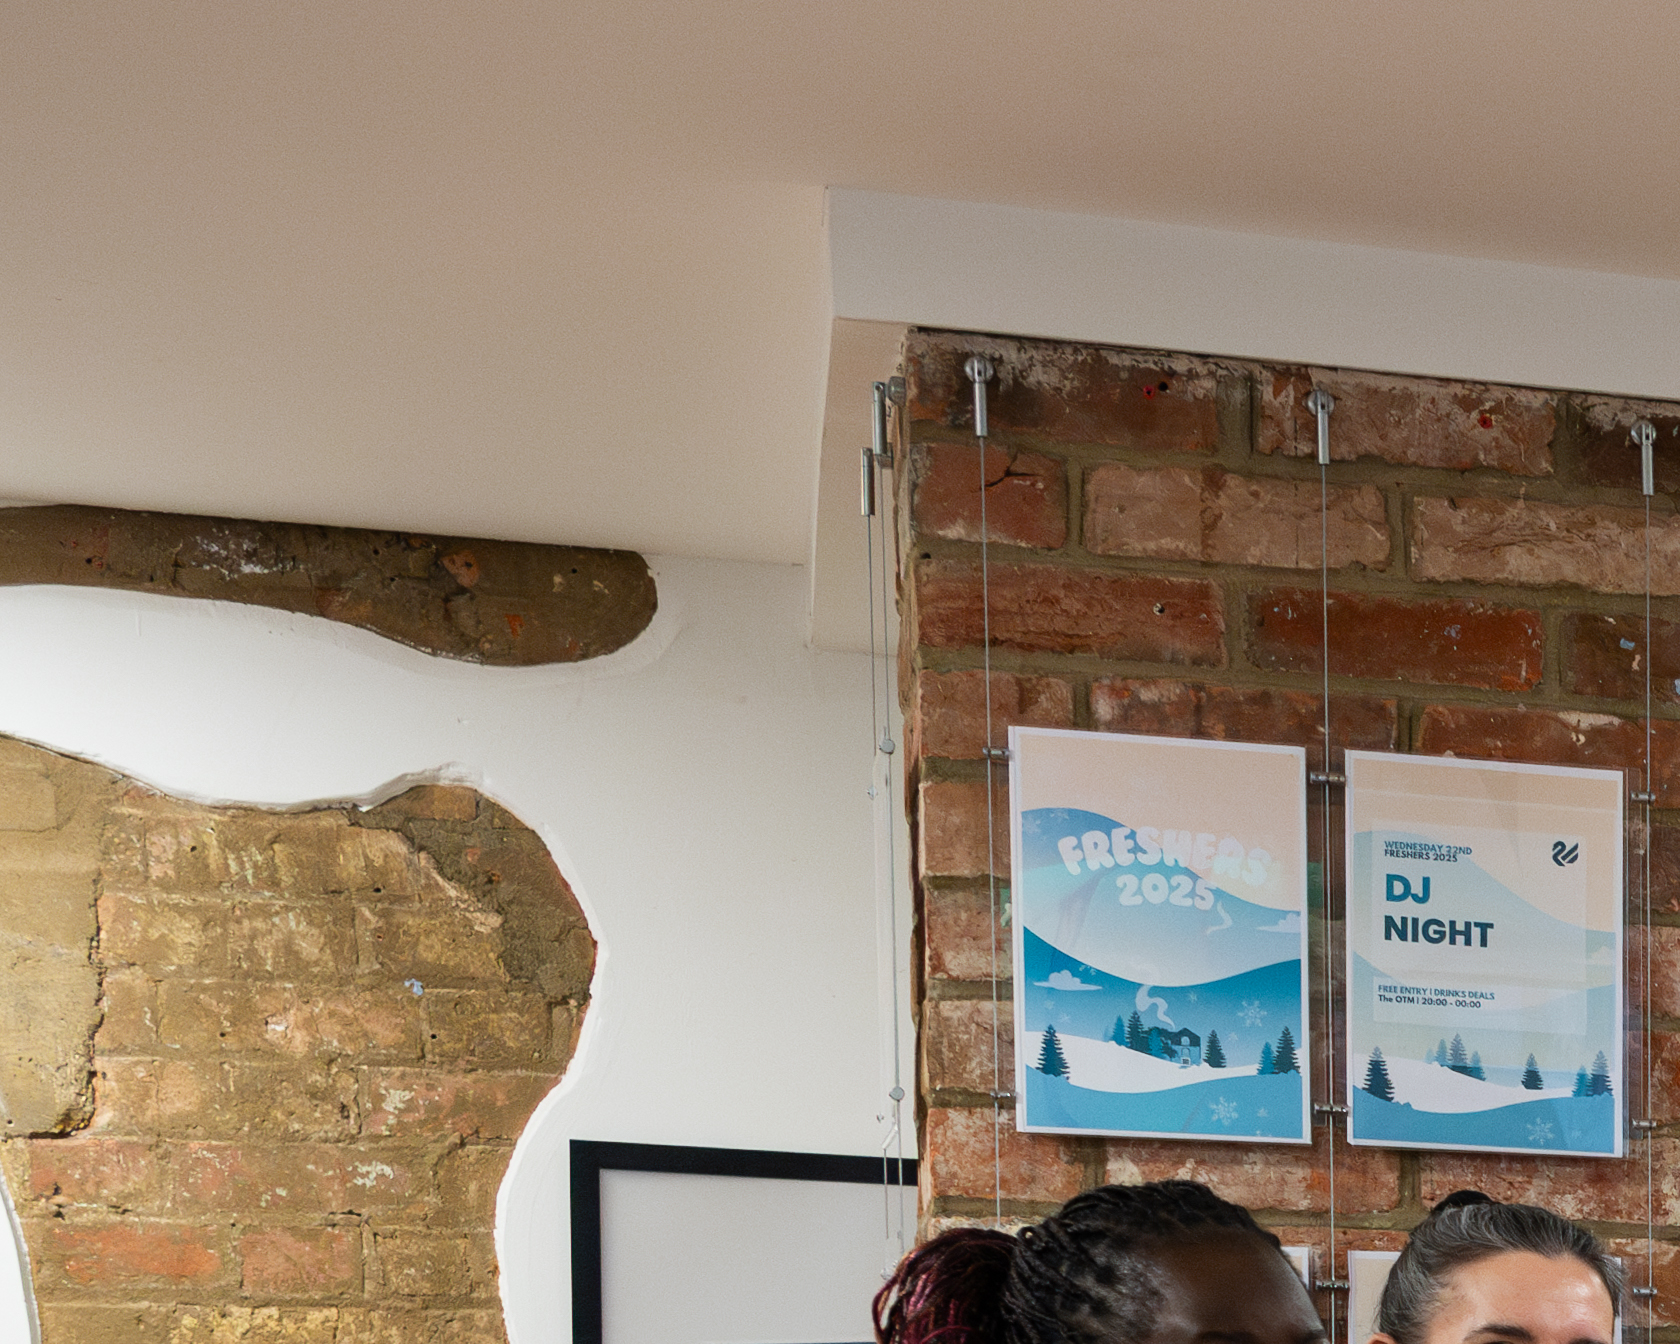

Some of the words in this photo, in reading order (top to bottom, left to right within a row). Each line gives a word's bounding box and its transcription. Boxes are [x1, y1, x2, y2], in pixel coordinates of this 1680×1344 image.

[1057, 826, 1272, 887] FRESHERS
[1384, 841, 1444, 852] WEDNESDAY
[1446, 846, 1473, 855] 22ND
[1384, 849, 1430, 860] FRESHERS
[1433, 853, 1458, 862] 2025
[1116, 873, 1217, 910] 2025
[1386, 873, 1430, 904] DJ
[1384, 914, 1495, 948] NIGHT
[1378, 985, 1398, 994] FREE
[1400, 986, 1428, 996] ENTRY
[1434, 988, 1467, 998] DRINKS
[1468, 991, 1495, 1000] DEALS
[1395, 996, 1415, 1004] OTM
[1421, 997, 1447, 1006] 20:00
[1455, 1000, 1481, 1008] 00:00
